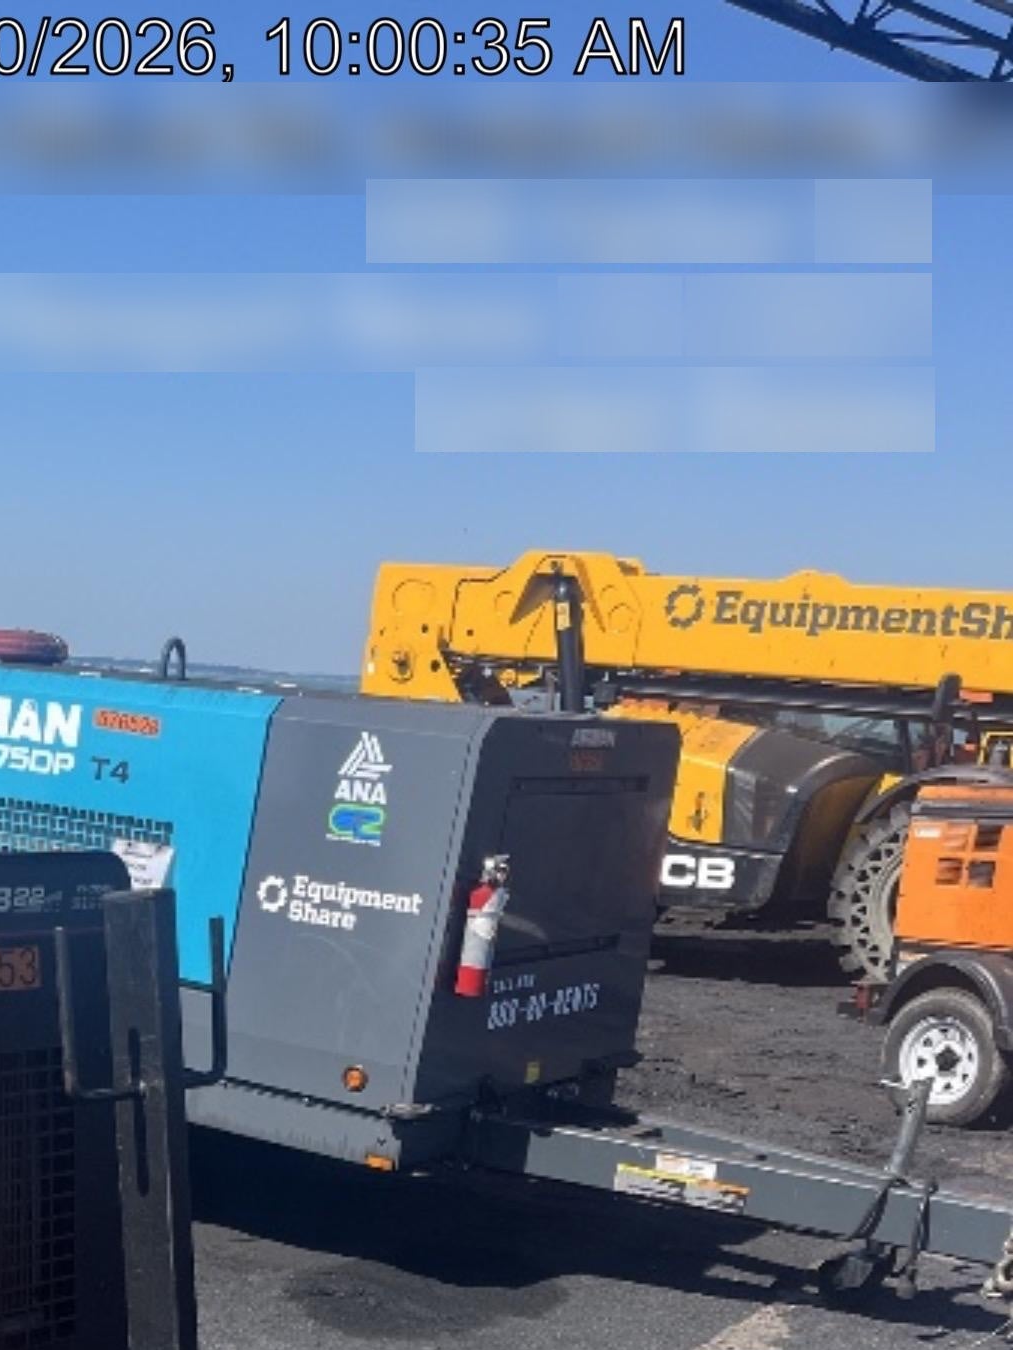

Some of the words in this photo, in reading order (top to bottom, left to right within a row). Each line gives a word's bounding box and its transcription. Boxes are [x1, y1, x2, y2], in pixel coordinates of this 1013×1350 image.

[91, 756, 130, 783] T4
[334, 779, 387, 805] ANA
[292, 875, 423, 915] Equipment
[288, 899, 357, 930] Share
